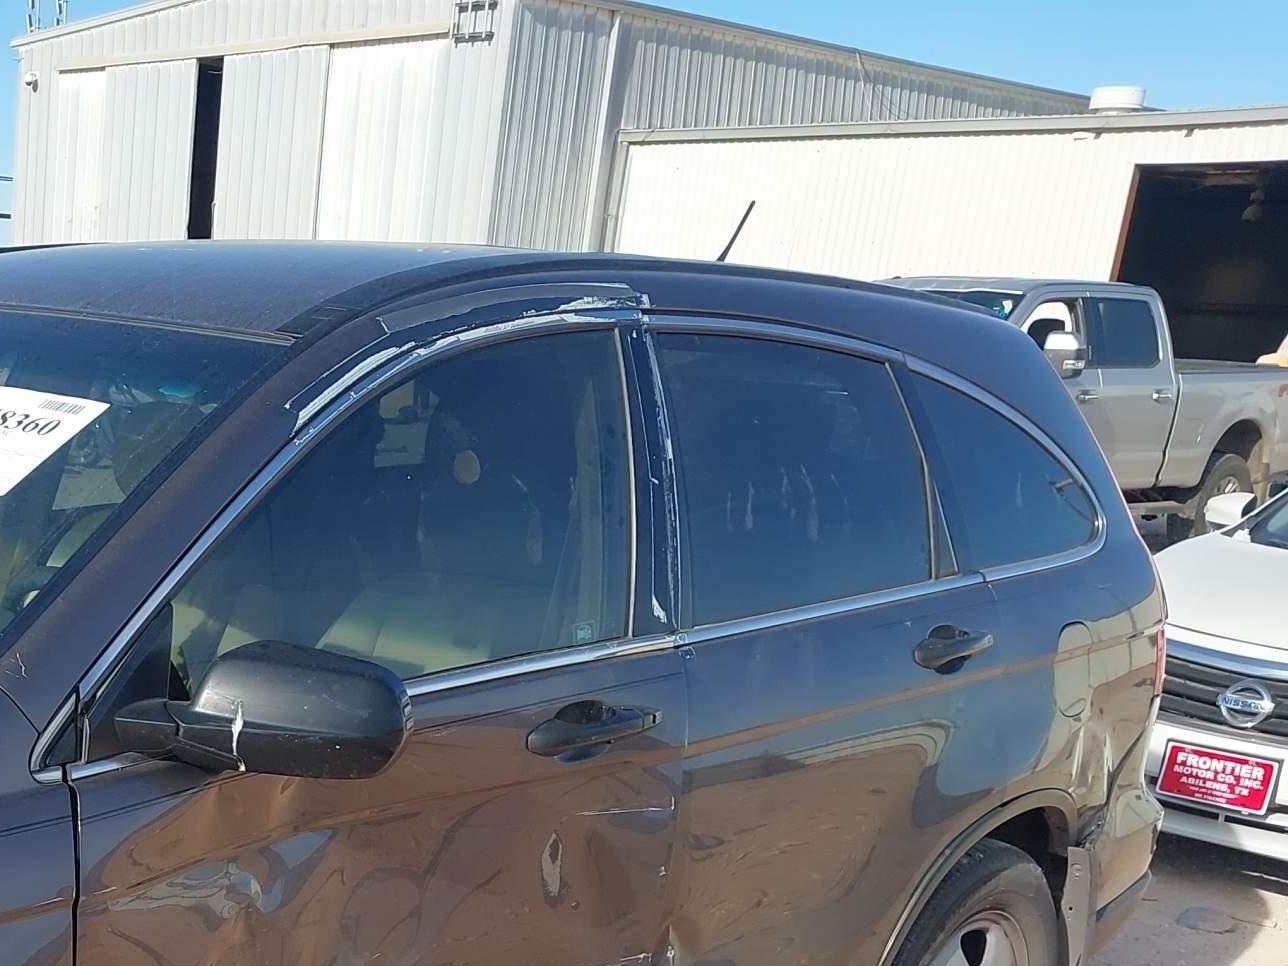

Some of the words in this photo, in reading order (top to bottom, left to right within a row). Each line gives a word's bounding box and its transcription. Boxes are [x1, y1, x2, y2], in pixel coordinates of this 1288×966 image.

[1173, 764, 1215, 780] MOTOR
[1239, 778, 1264, 790] INC.
[1176, 751, 1265, 780] FRONTIER
[1180, 776, 1231, 794] ABILENE,
[1234, 786, 1250, 796] TX
